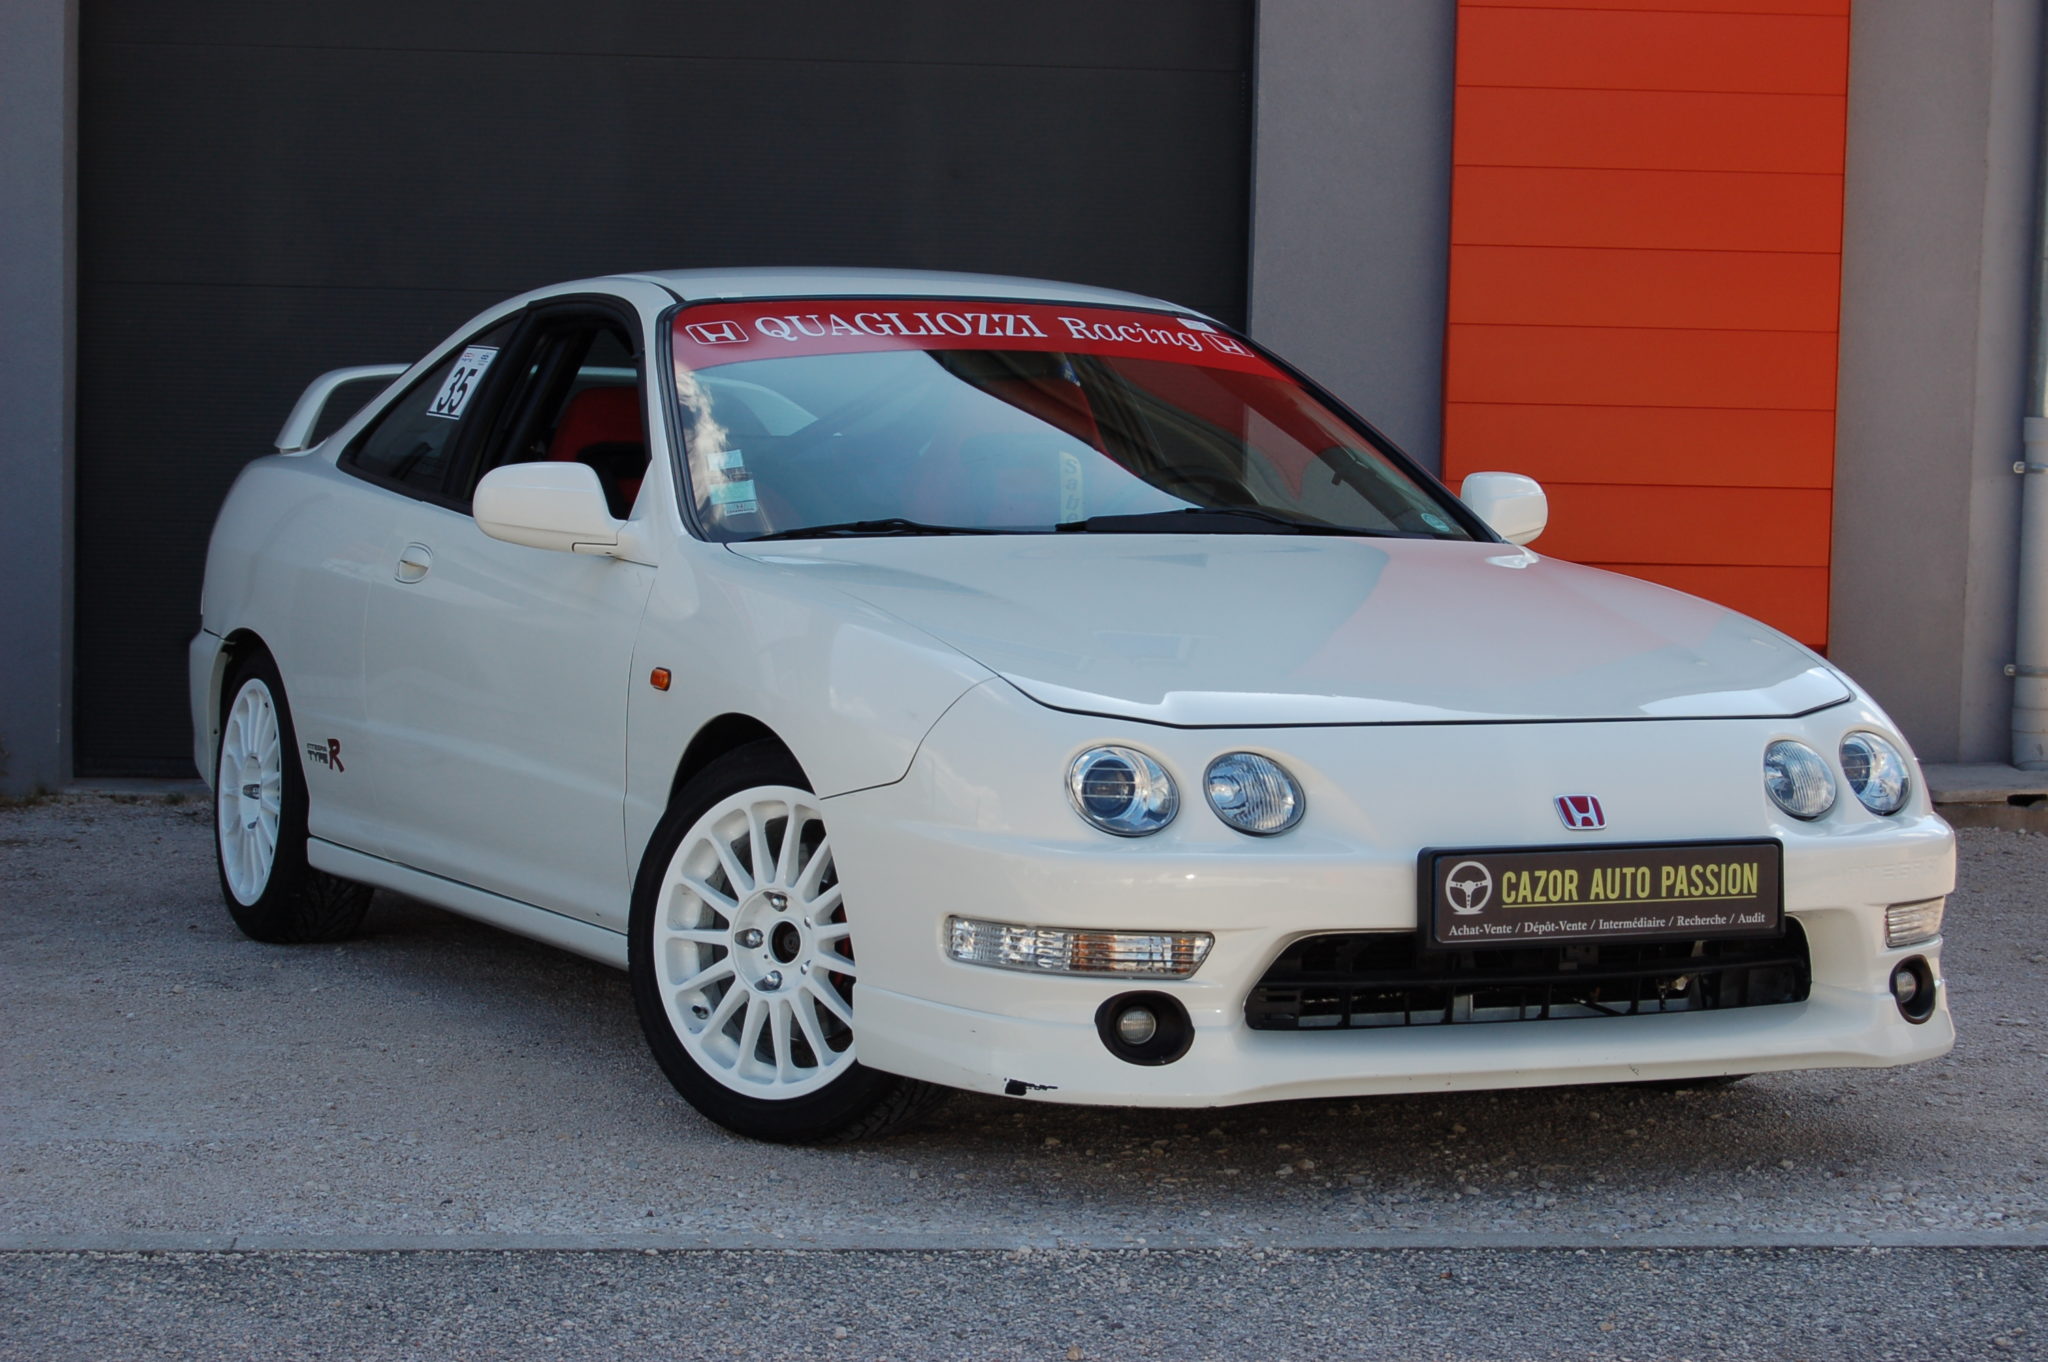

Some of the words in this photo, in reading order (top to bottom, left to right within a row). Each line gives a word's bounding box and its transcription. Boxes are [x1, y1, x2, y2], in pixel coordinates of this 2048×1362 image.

[754, 312, 1048, 342] QUAGLIOZZI
[1057, 316, 1203, 352] Racing
[436, 366, 478, 414] 35
[327, 738, 345, 773] R
[1502, 869, 1579, 904] CAZOR
[1590, 865, 1651, 900] AUTO
[1661, 862, 1758, 897] PASSION
[1449, 923, 1513, 936] Achat-Vente
[1524, 920, 1587, 935] Dépôt-Vente
[1599, 916, 1666, 930] Intermédiaire
[1676, 913, 1727, 927] Recherche
[1738, 912, 1766, 925] Audit
